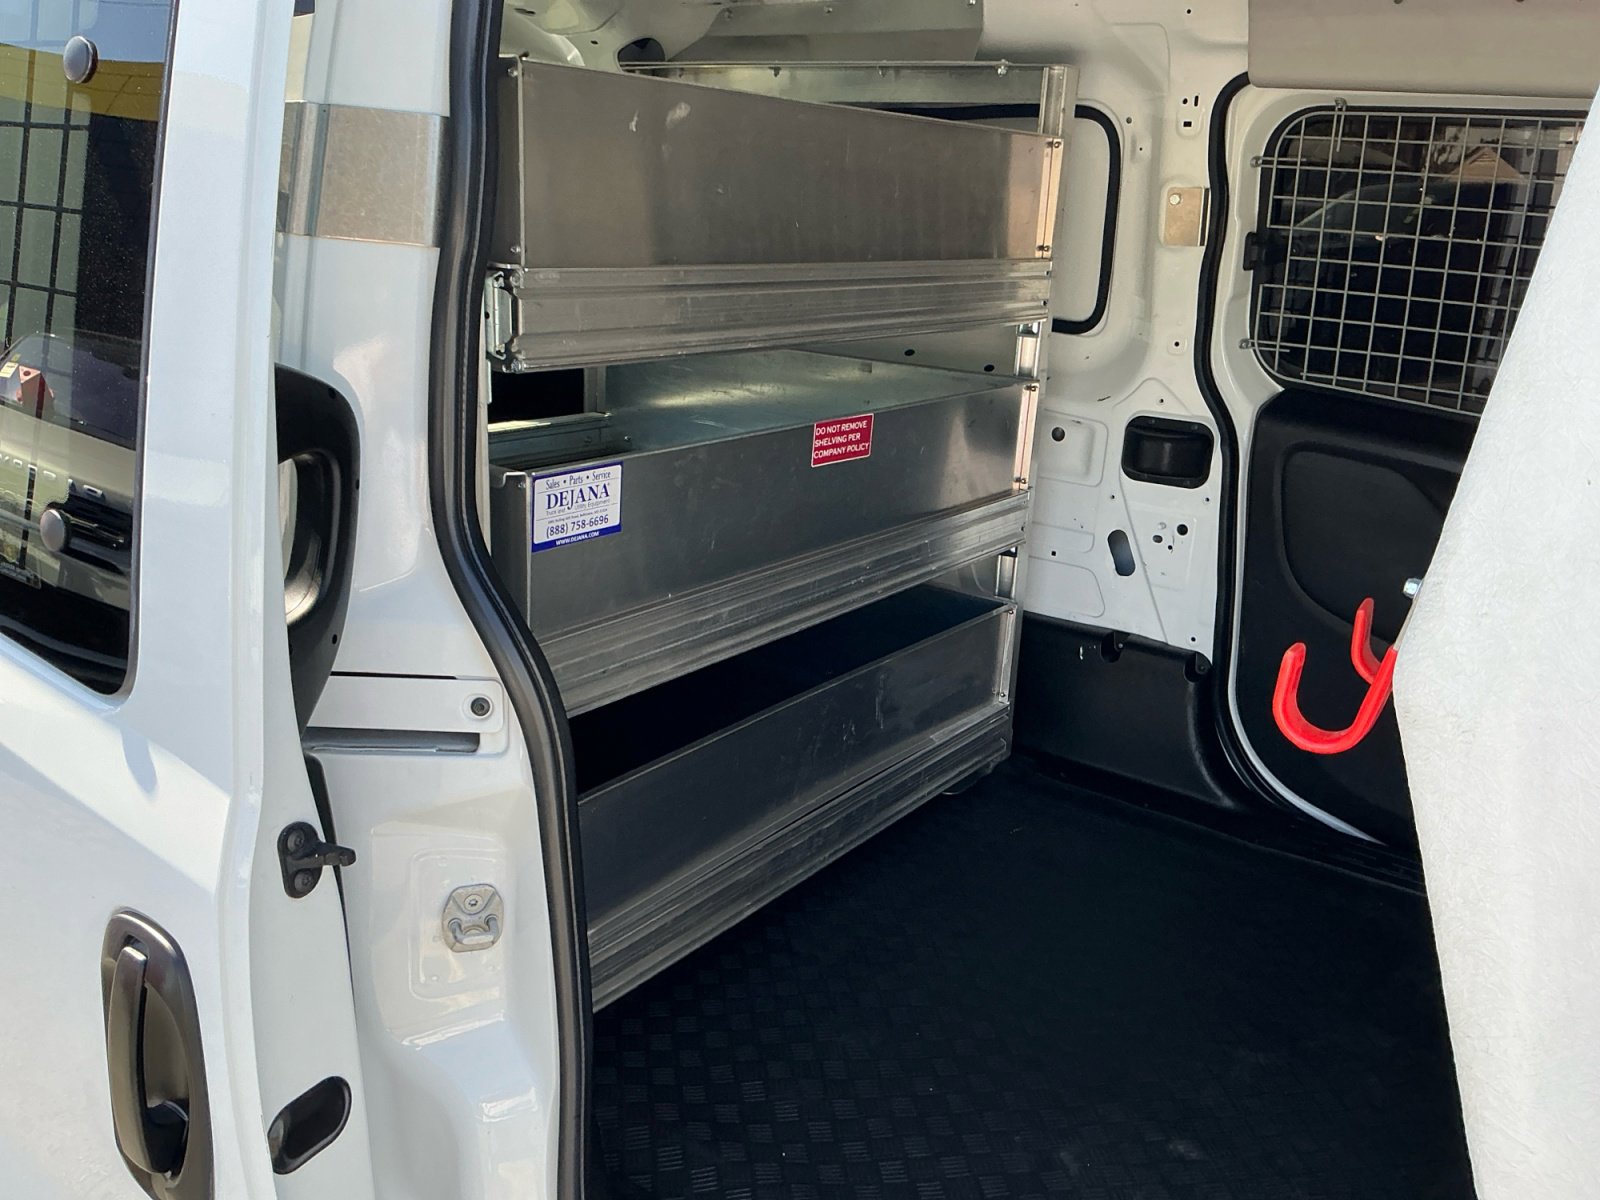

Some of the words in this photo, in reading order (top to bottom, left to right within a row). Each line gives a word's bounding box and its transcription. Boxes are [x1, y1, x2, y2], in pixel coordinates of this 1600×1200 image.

[827, 425, 840, 434] NOT
[841, 421, 867, 431] REMOVE
[815, 435, 847, 447] SHELVING
[848, 433, 860, 441] PER
[814, 446, 847, 458] COMPANY
[847, 442, 869, 453] POLICY
[546, 479, 560, 490] Sales
[569, 475, 583, 485] Parts
[592, 470, 611, 481] Service
[546, 483, 609, 510] DEJANA
[546, 523, 568, 538] (888)
[571, 514, 609, 531] 758-6696
[556, 531, 599, 545] WWW.DEJANA.COM
